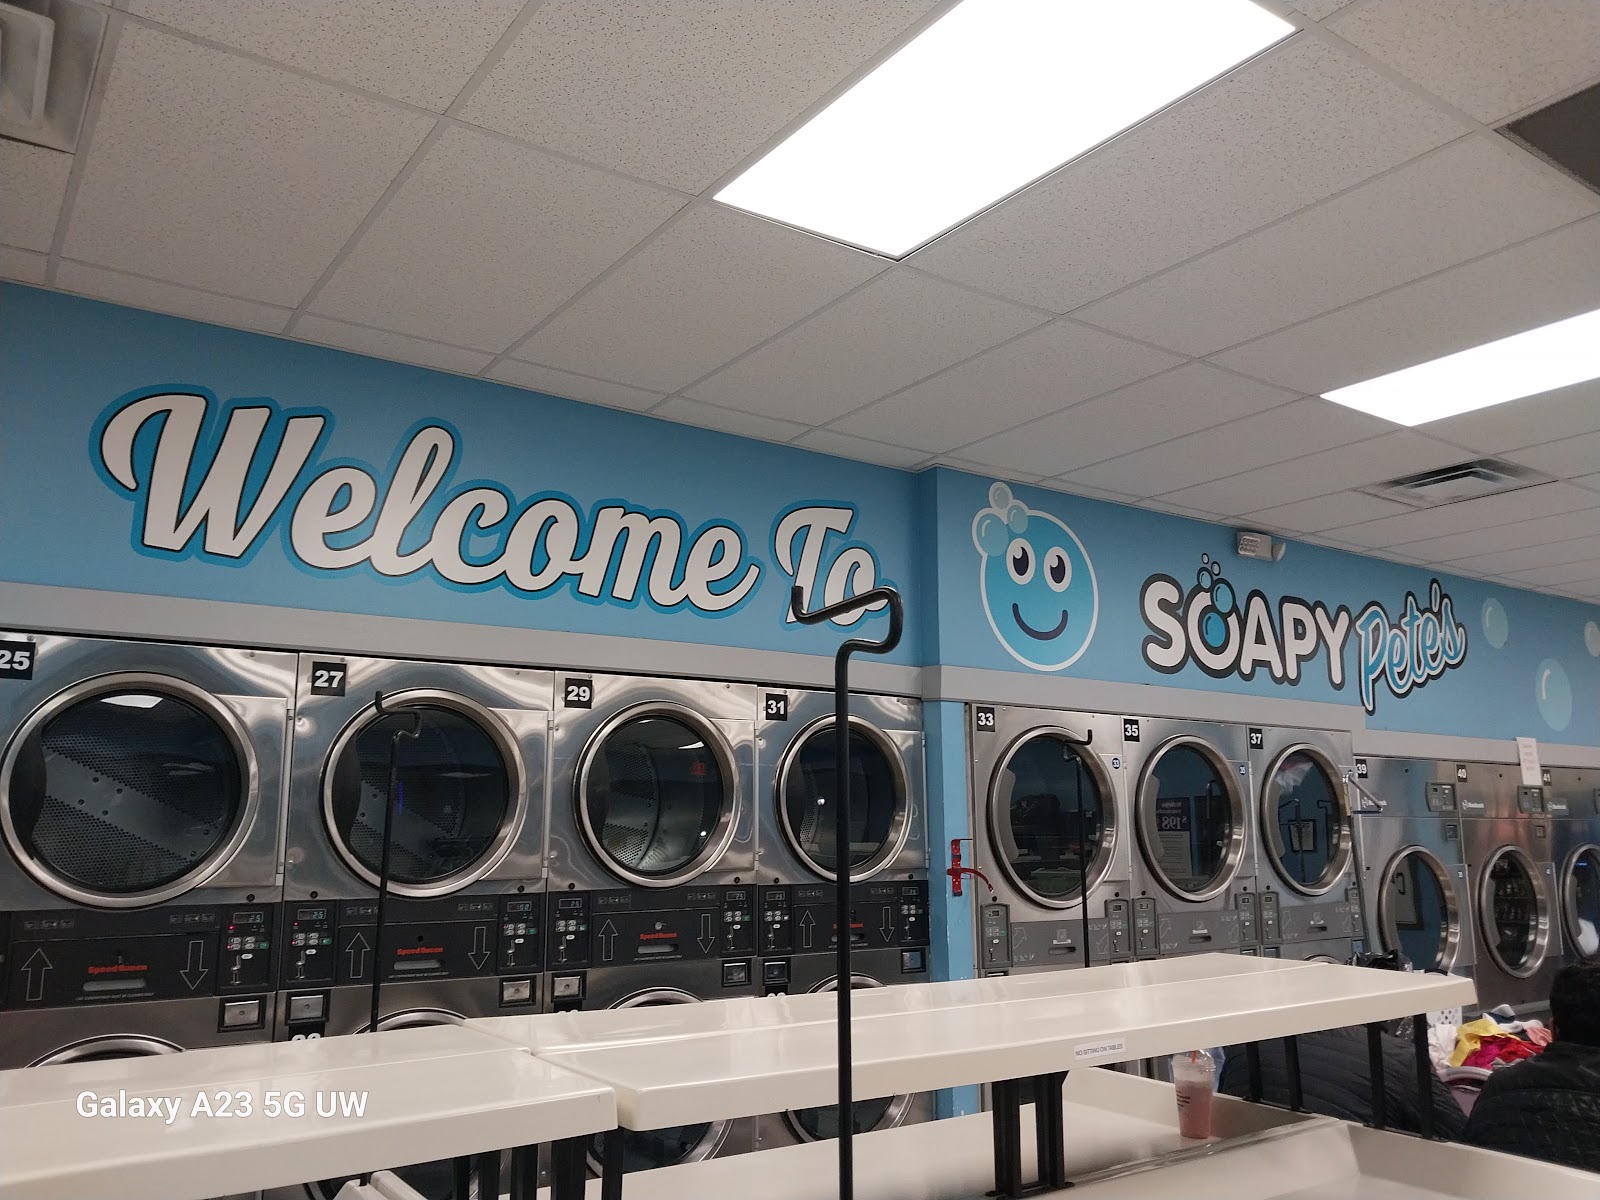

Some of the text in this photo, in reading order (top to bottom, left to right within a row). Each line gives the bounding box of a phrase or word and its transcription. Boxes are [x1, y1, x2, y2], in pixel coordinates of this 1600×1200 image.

[99, 391, 890, 627] Welcome To
[1142, 576, 1466, 714] SOAPY Pete's
[0, 649, 30, 671] 25
[314, 670, 345, 688] 27
[567, 685, 591, 702] 29
[767, 699, 785, 715] 31
[977, 712, 995, 726] 33
[1124, 724, 1139, 737] 35
[1250, 733, 1262, 745] 37
[1357, 763, 1367, 774] 39
[1457, 769, 1467, 779] 40
